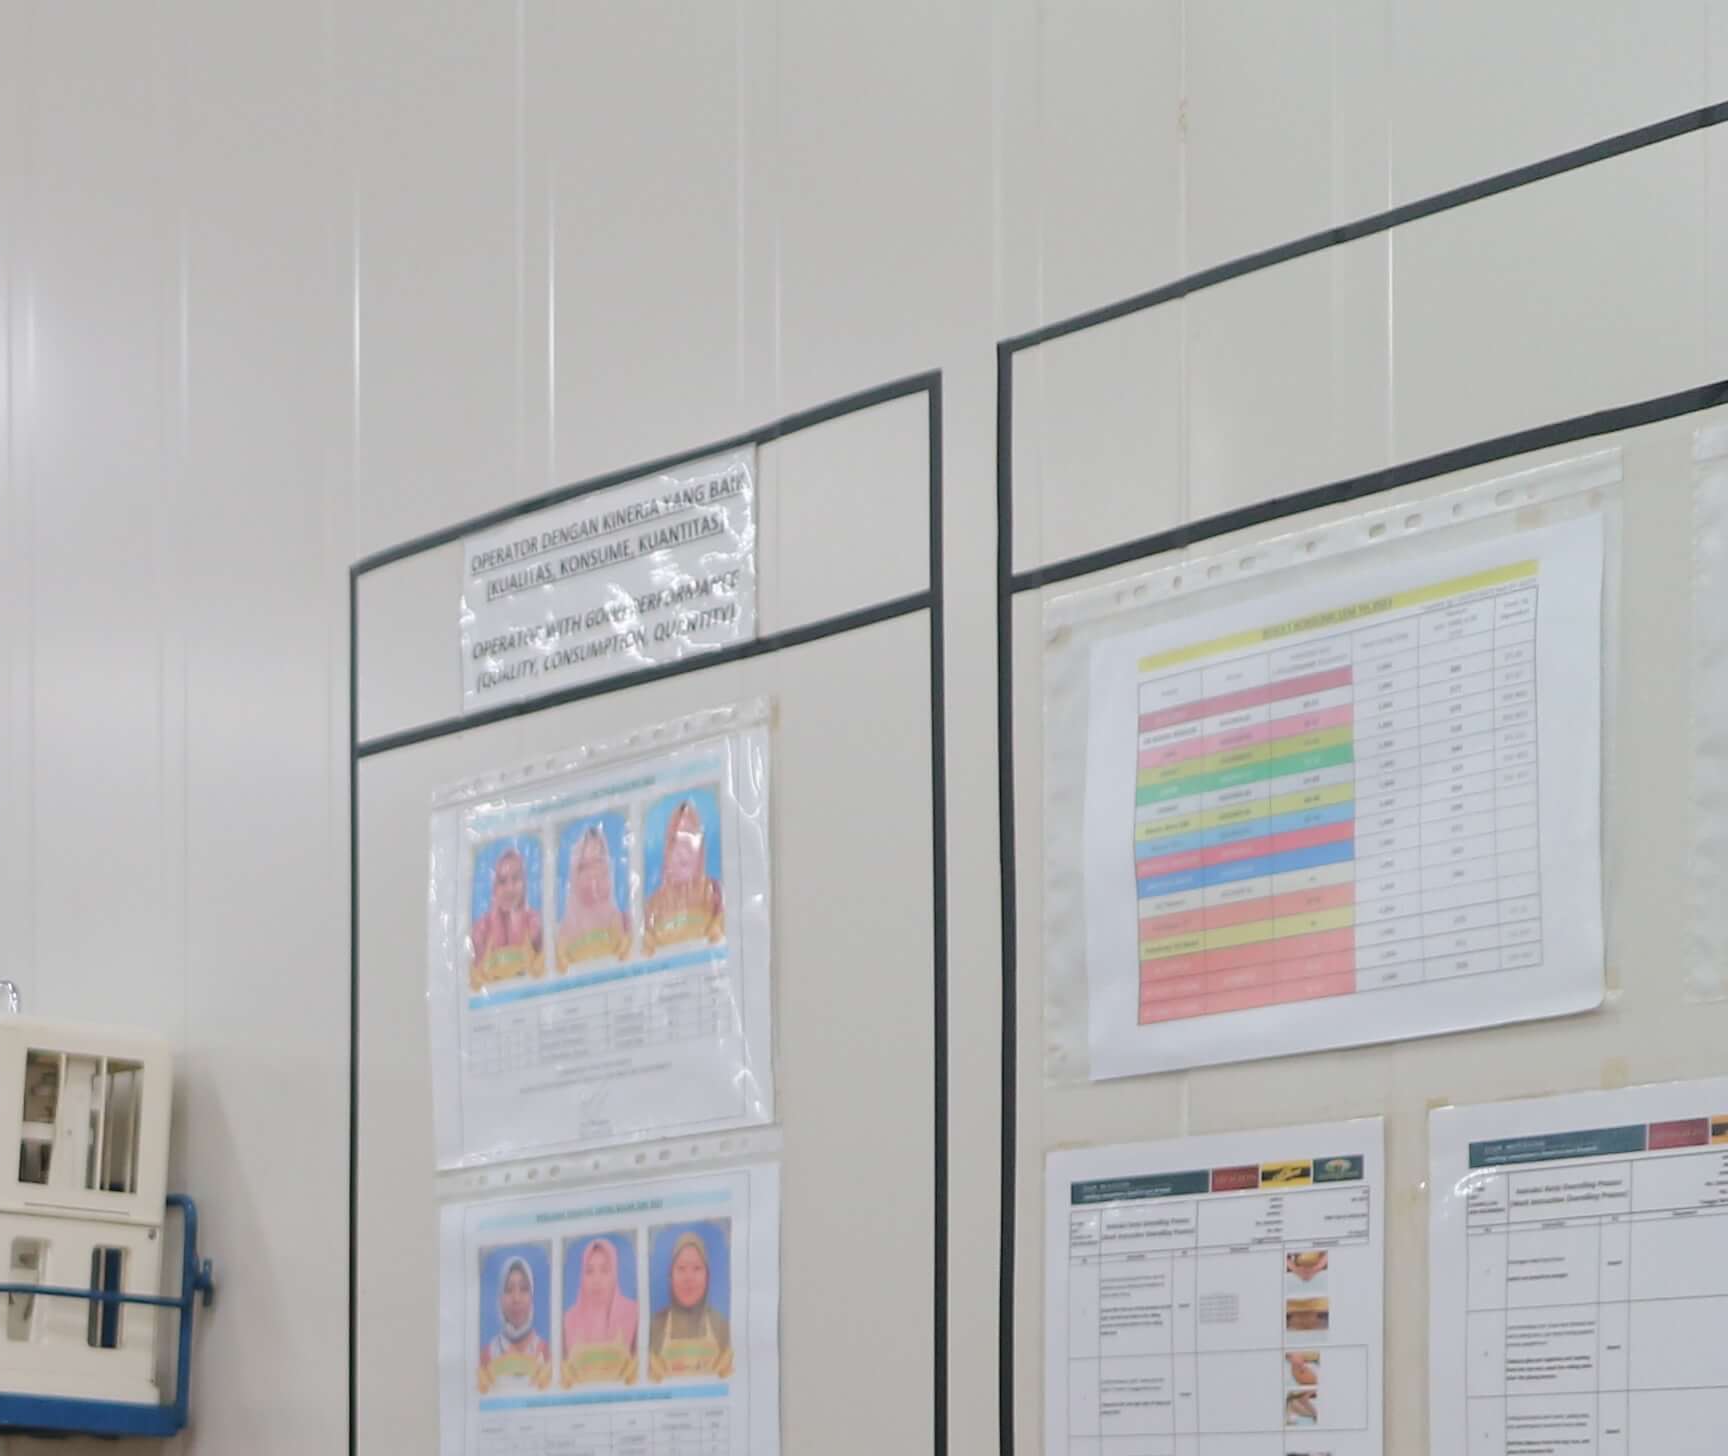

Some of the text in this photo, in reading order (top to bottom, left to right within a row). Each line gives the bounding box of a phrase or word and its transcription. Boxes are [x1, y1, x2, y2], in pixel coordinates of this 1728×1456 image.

[471, 535, 538, 572] OPERATOR
[541, 517, 598, 549] DENGAN
[602, 499, 661, 531] KINERJA
[662, 484, 705, 510] YANG
[545, 612, 582, 639] WITH
[584, 602, 627, 630] GO
